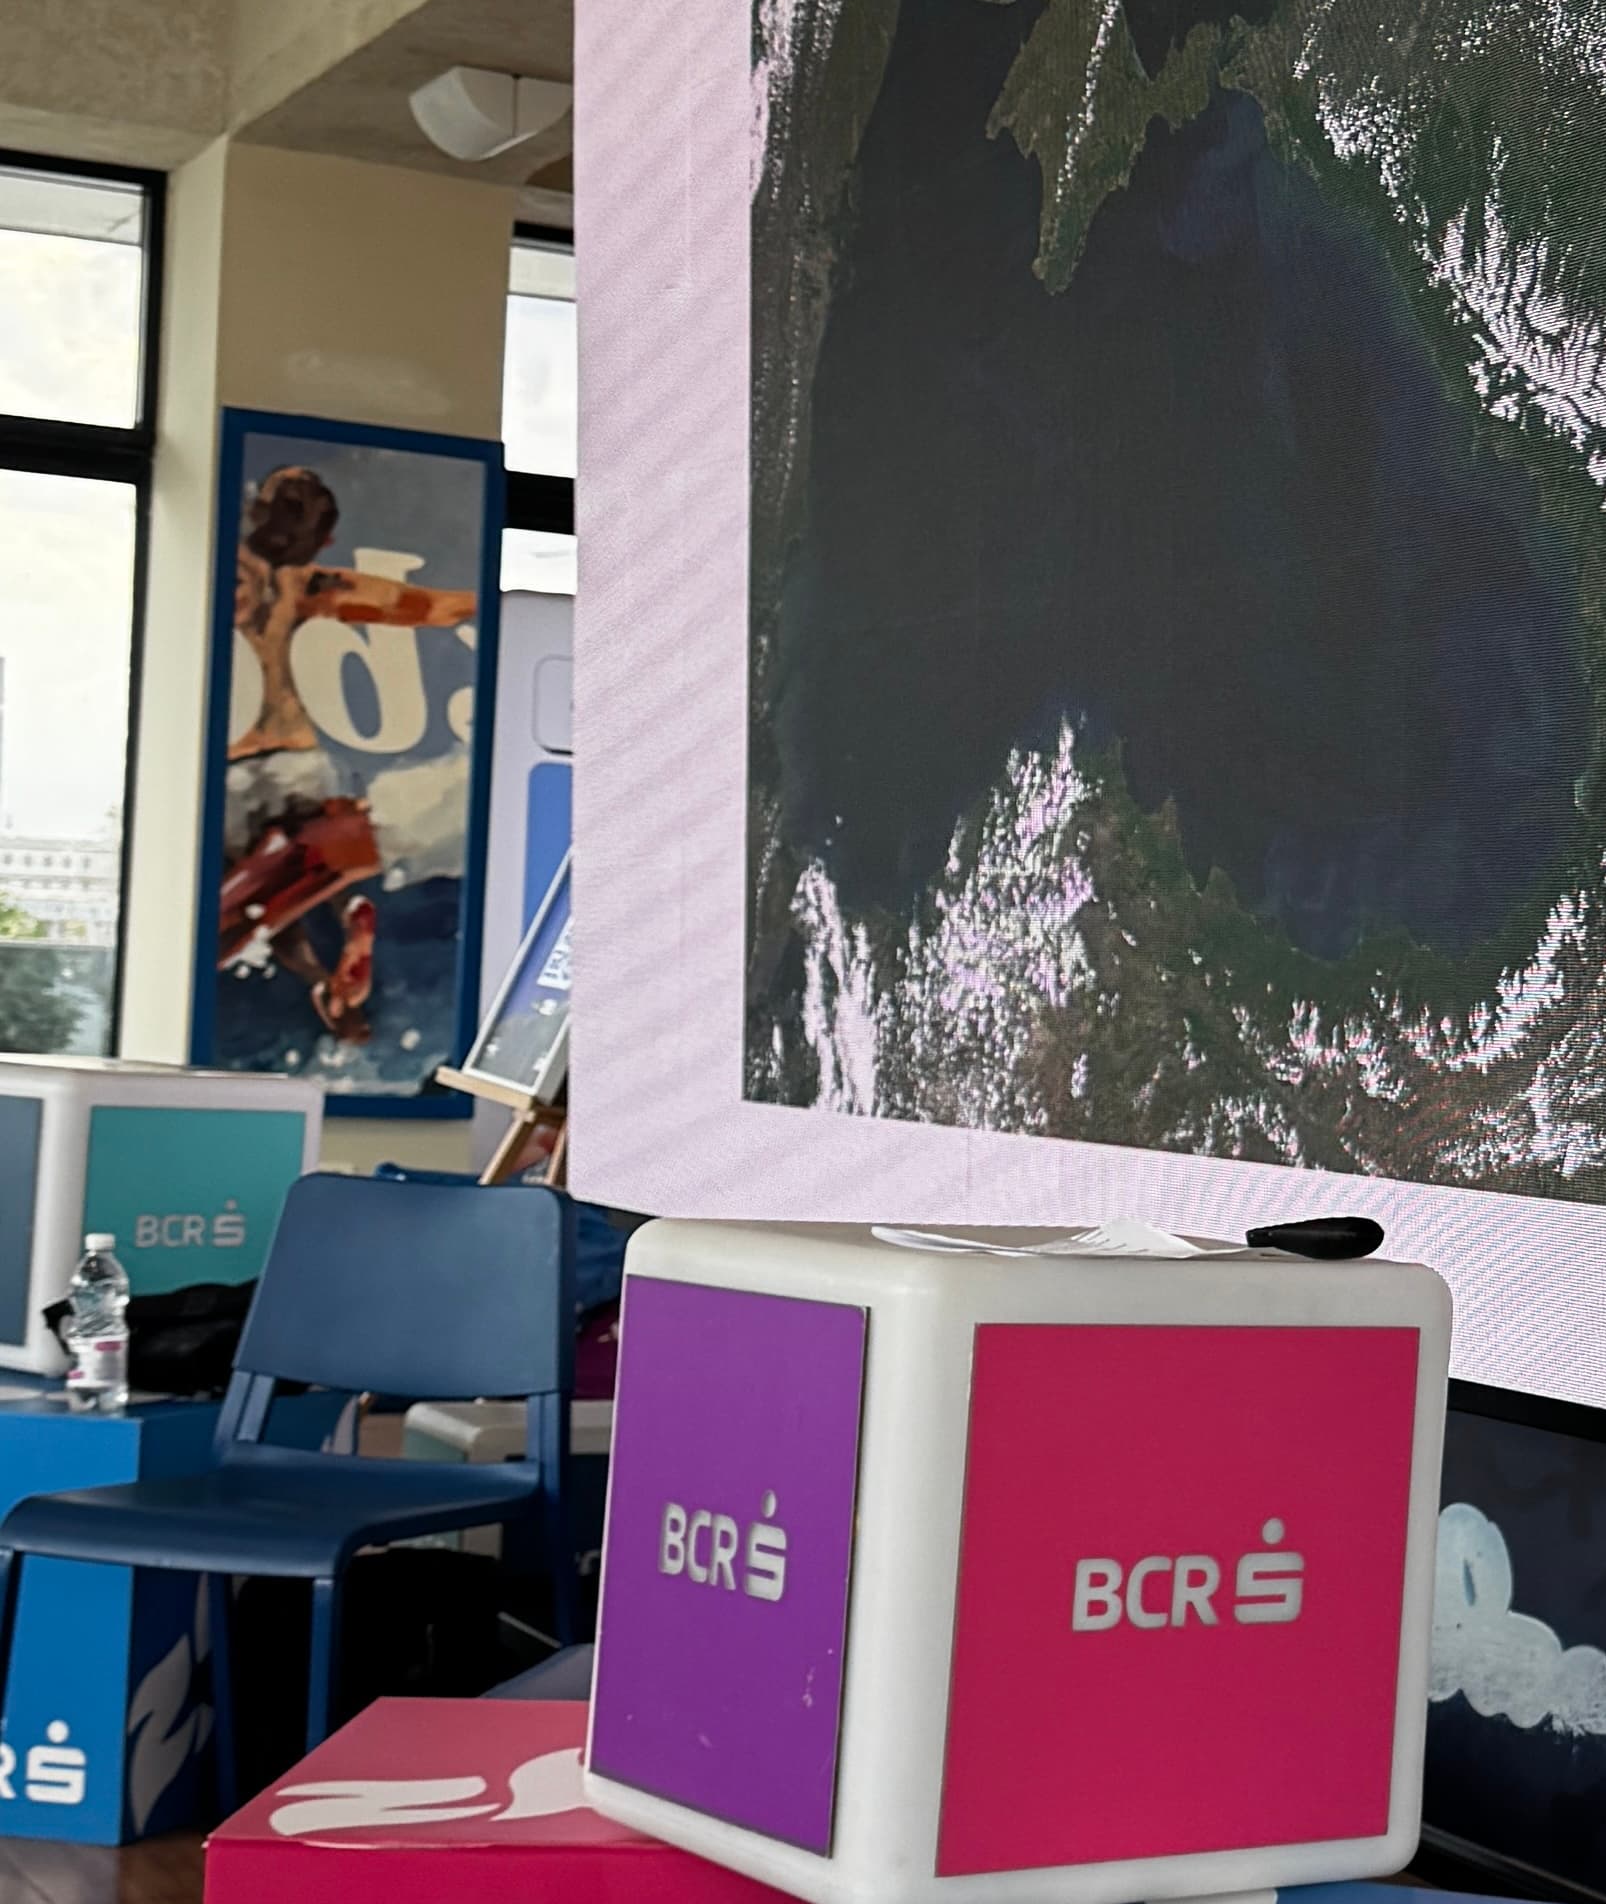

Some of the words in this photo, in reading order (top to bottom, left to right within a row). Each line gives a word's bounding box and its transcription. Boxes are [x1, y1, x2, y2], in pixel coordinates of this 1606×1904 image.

[135, 1214, 205, 1249] BCR
[659, 1502, 739, 1591] BCR
[1072, 1554, 1221, 1633] BCR
